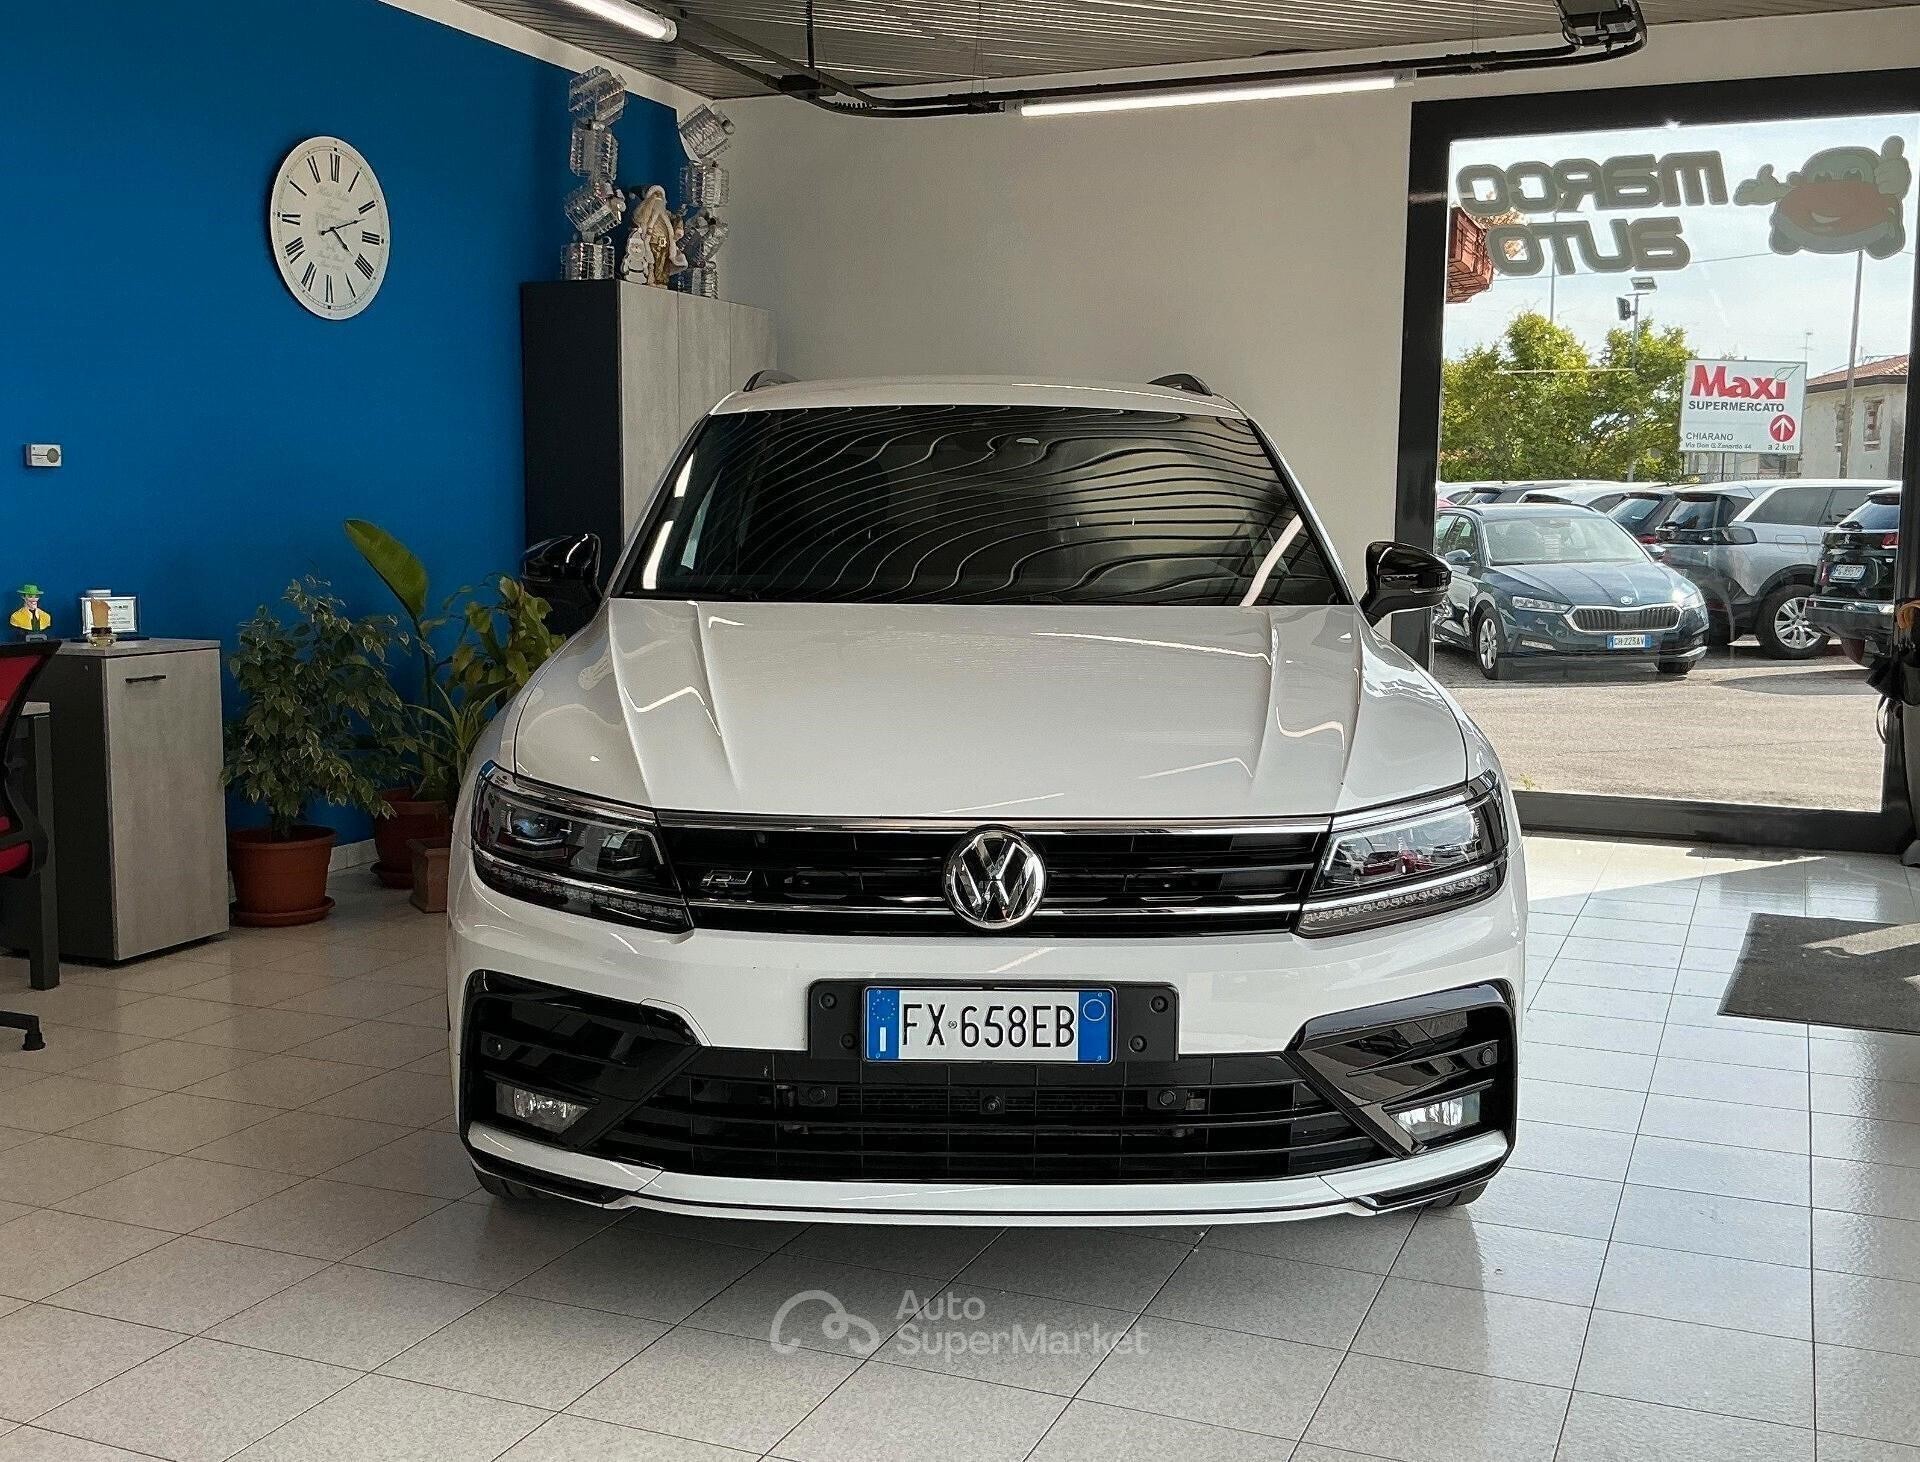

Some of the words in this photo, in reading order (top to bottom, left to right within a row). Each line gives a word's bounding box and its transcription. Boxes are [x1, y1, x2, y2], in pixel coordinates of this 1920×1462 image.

[1689, 364, 1787, 400] Maxi
[1688, 400, 1785, 413] SUPERMERCATO
[1685, 432, 1734, 441] CHIARANO
[1781, 443, 1795, 451] km
[902, 1003, 946, 1047] FX
[960, 1004, 1076, 1048] 658EB
